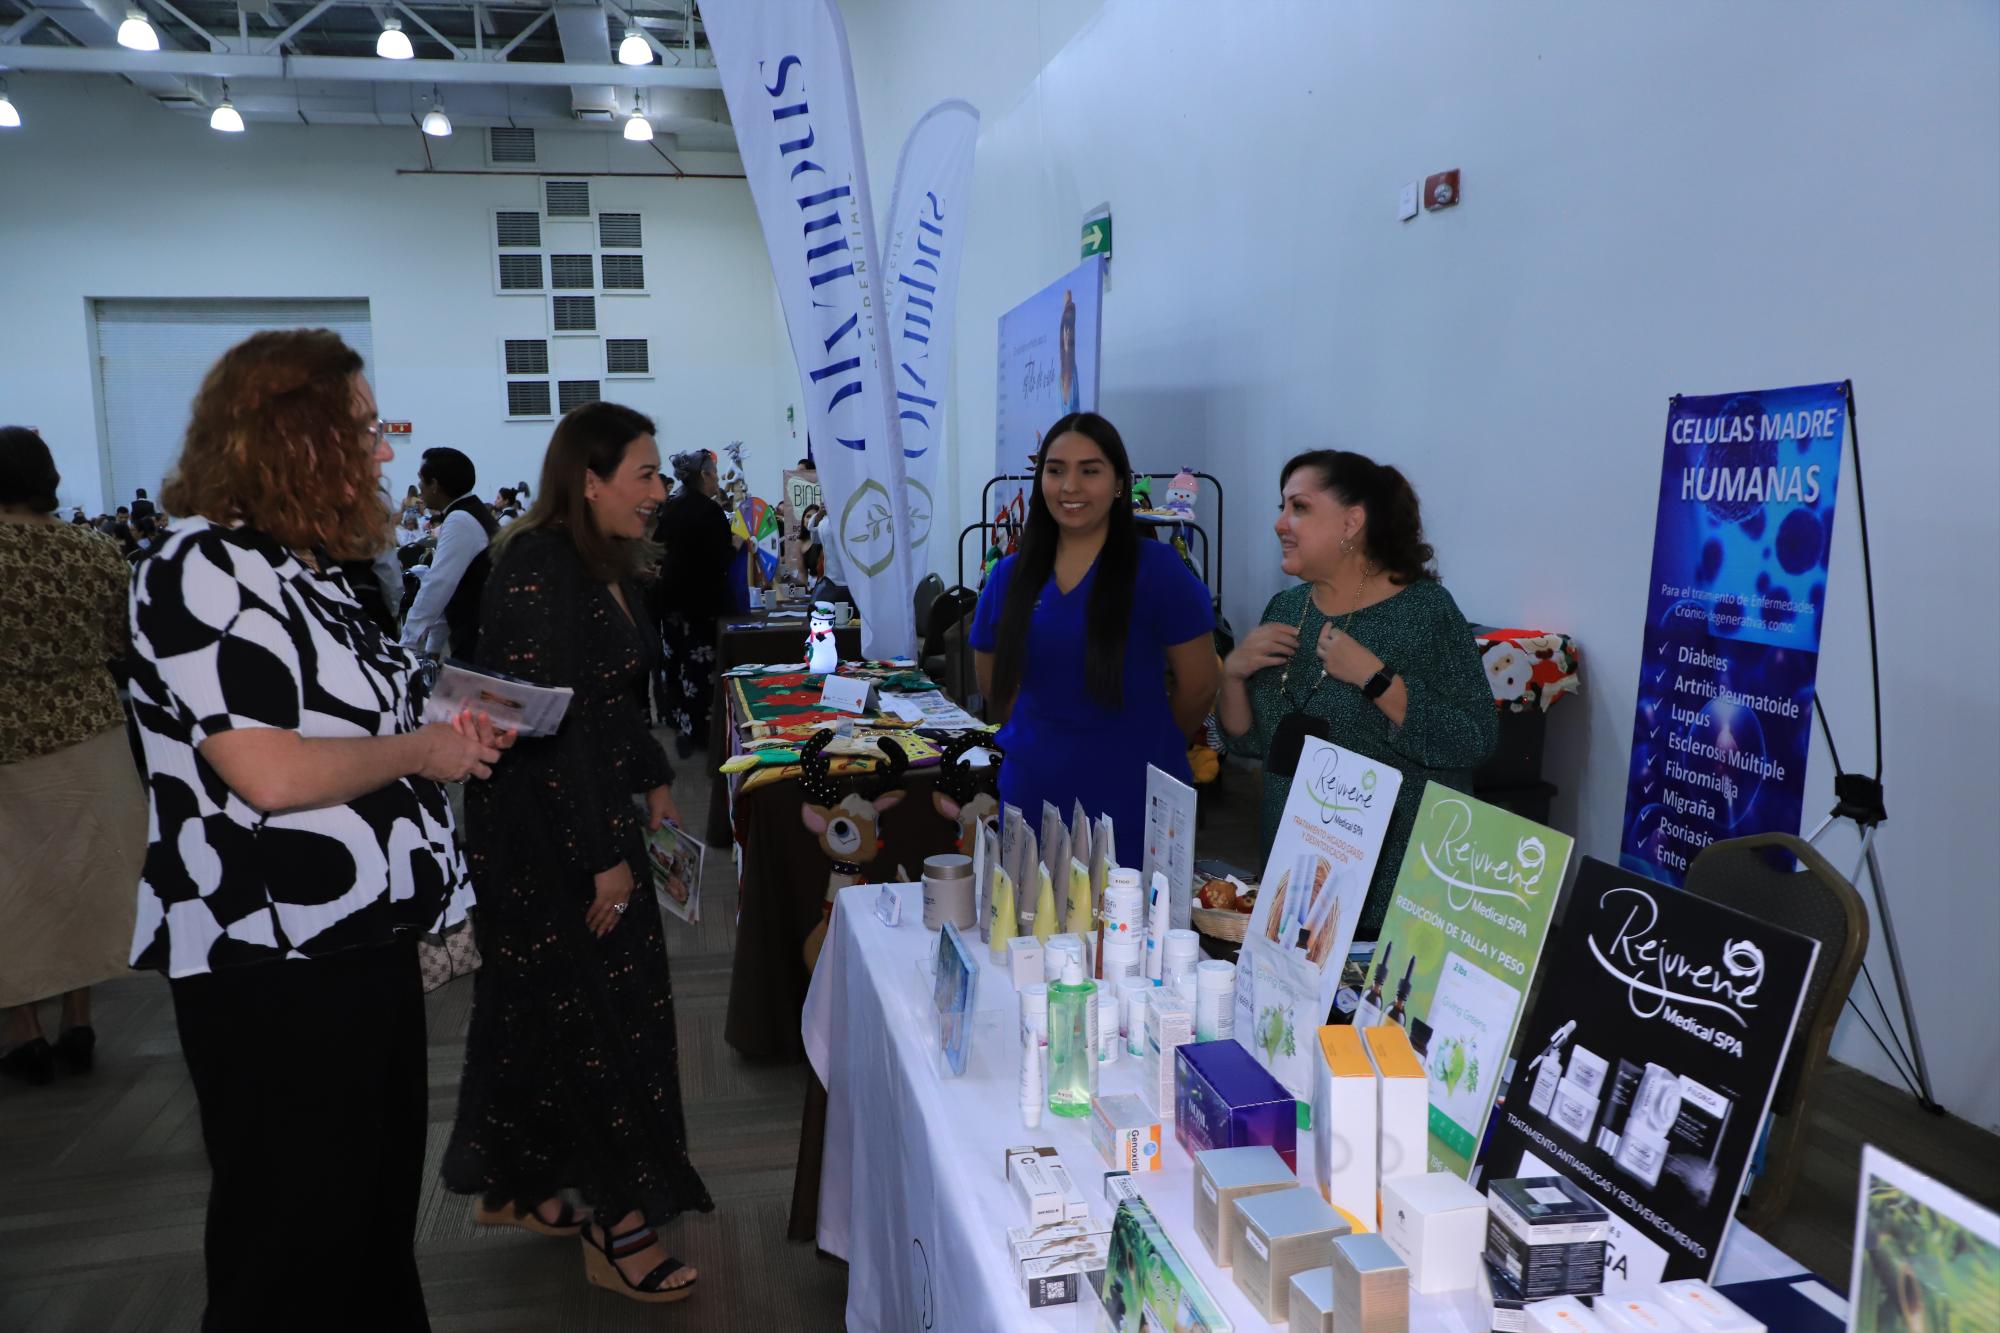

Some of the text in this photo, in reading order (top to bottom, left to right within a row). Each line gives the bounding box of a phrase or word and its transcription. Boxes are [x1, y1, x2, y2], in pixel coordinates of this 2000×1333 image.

[1672, 407, 1838, 445] CELULAS MADRE
[1681, 464, 1821, 503] HUMANAS
[1661, 583, 1680, 598] Para
[1681, 586, 1690, 598] el
[1736, 593, 1749, 606] de
[1751, 594, 1815, 615] Enfermedades
[1678, 646, 1729, 672] Diabetes
[1671, 703, 1711, 727] Lupus
[1674, 675, 1800, 719] Artritis Reumatoide
[1668, 732, 1786, 781] Esclerosis Múltiple
[1313, 747, 1373, 825] Rejuvene
[1665, 760, 1739, 800] Fibromialgia
[1662, 788, 1716, 820] Migraña
[1334, 814, 1364, 837] Medical SPA
[1430, 799, 1541, 912] Rejuvene
[1656, 845, 1687, 871] Entre
[1396, 895, 1526, 976] REDUCCIÓN DE TALLA Y PESO
[1471, 899, 1528, 939] Medical SPA
[1600, 887, 1763, 1018] Rejuvene
[1662, 1005, 1743, 1058] Medical SPA
[1130, 1129, 1140, 1172] Genoxidil
[1506, 1112, 1558, 1153] TRATAMIENTO
[1556, 1148, 1611, 1191] ANTIARRUGAS
[1611, 1185, 1619, 1196] Y
[1618, 1191, 1707, 1259] REJUVENECIMIENTO
